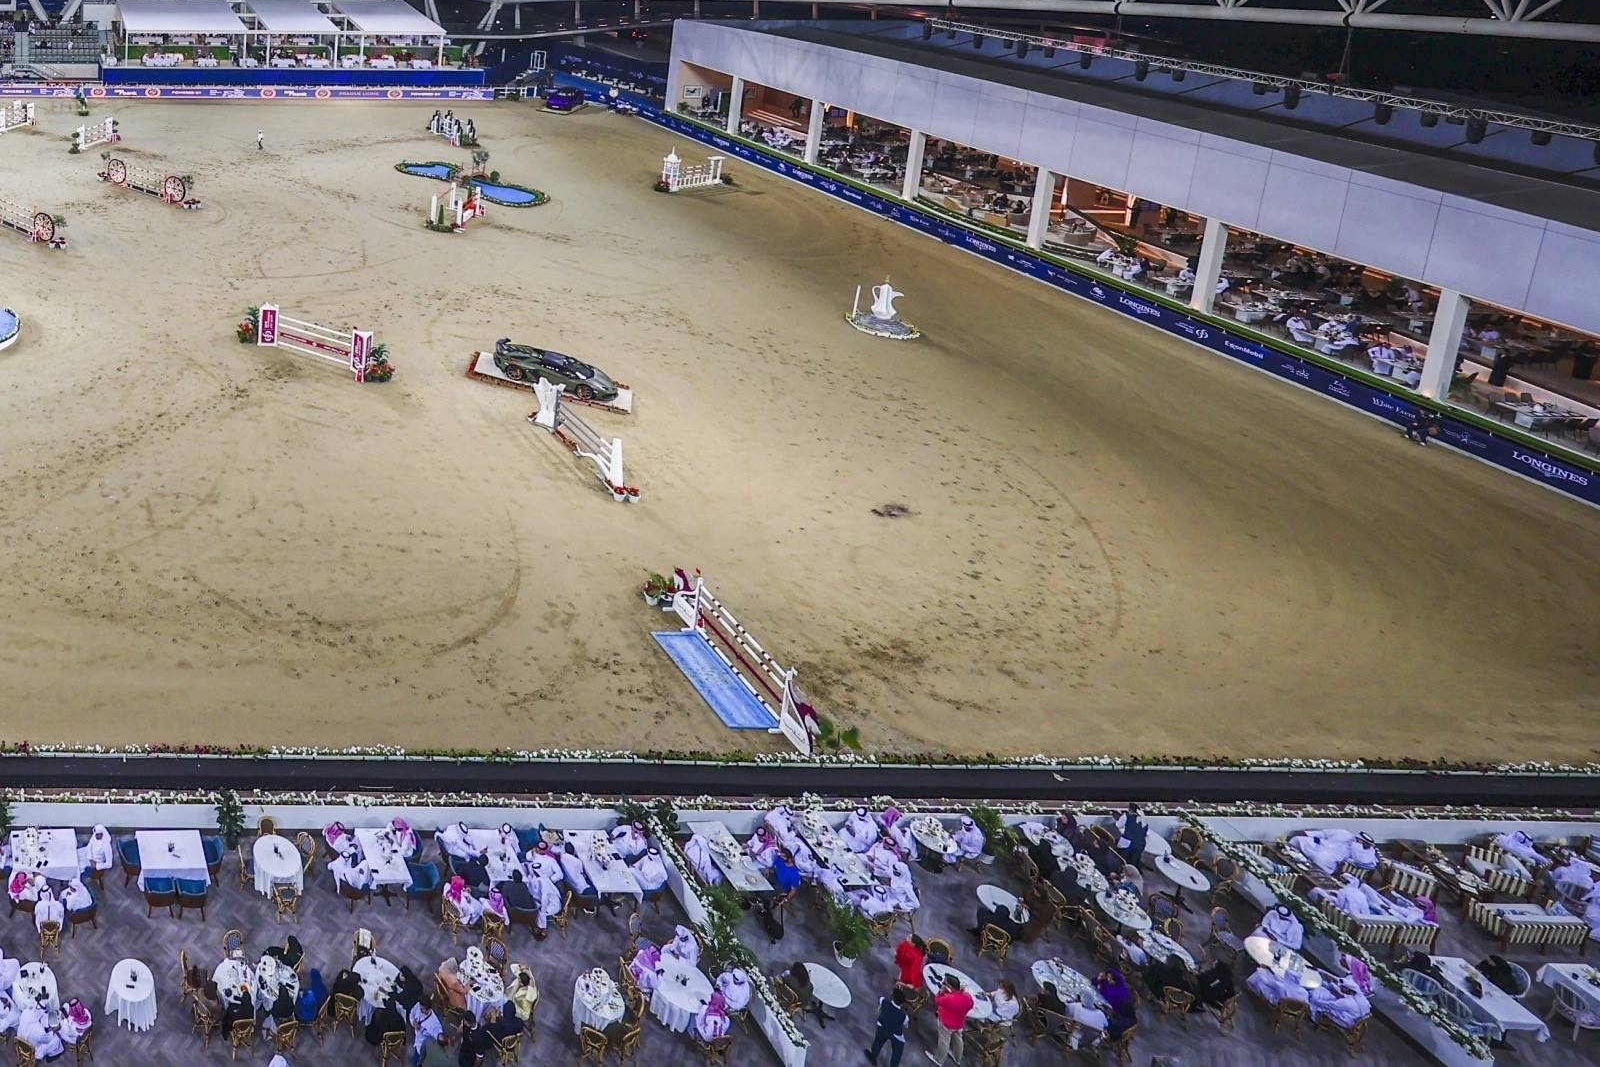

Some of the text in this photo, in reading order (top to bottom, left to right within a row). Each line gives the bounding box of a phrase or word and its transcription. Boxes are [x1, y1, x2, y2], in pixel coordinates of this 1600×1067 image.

[966, 236, 997, 253] LONGINES
[1119, 296, 1160, 318] LONGINES
[1224, 340, 1264, 359] ExxonMobil
[1372, 397, 1416, 420] White Event
[1513, 450, 1588, 486] LONGINES
